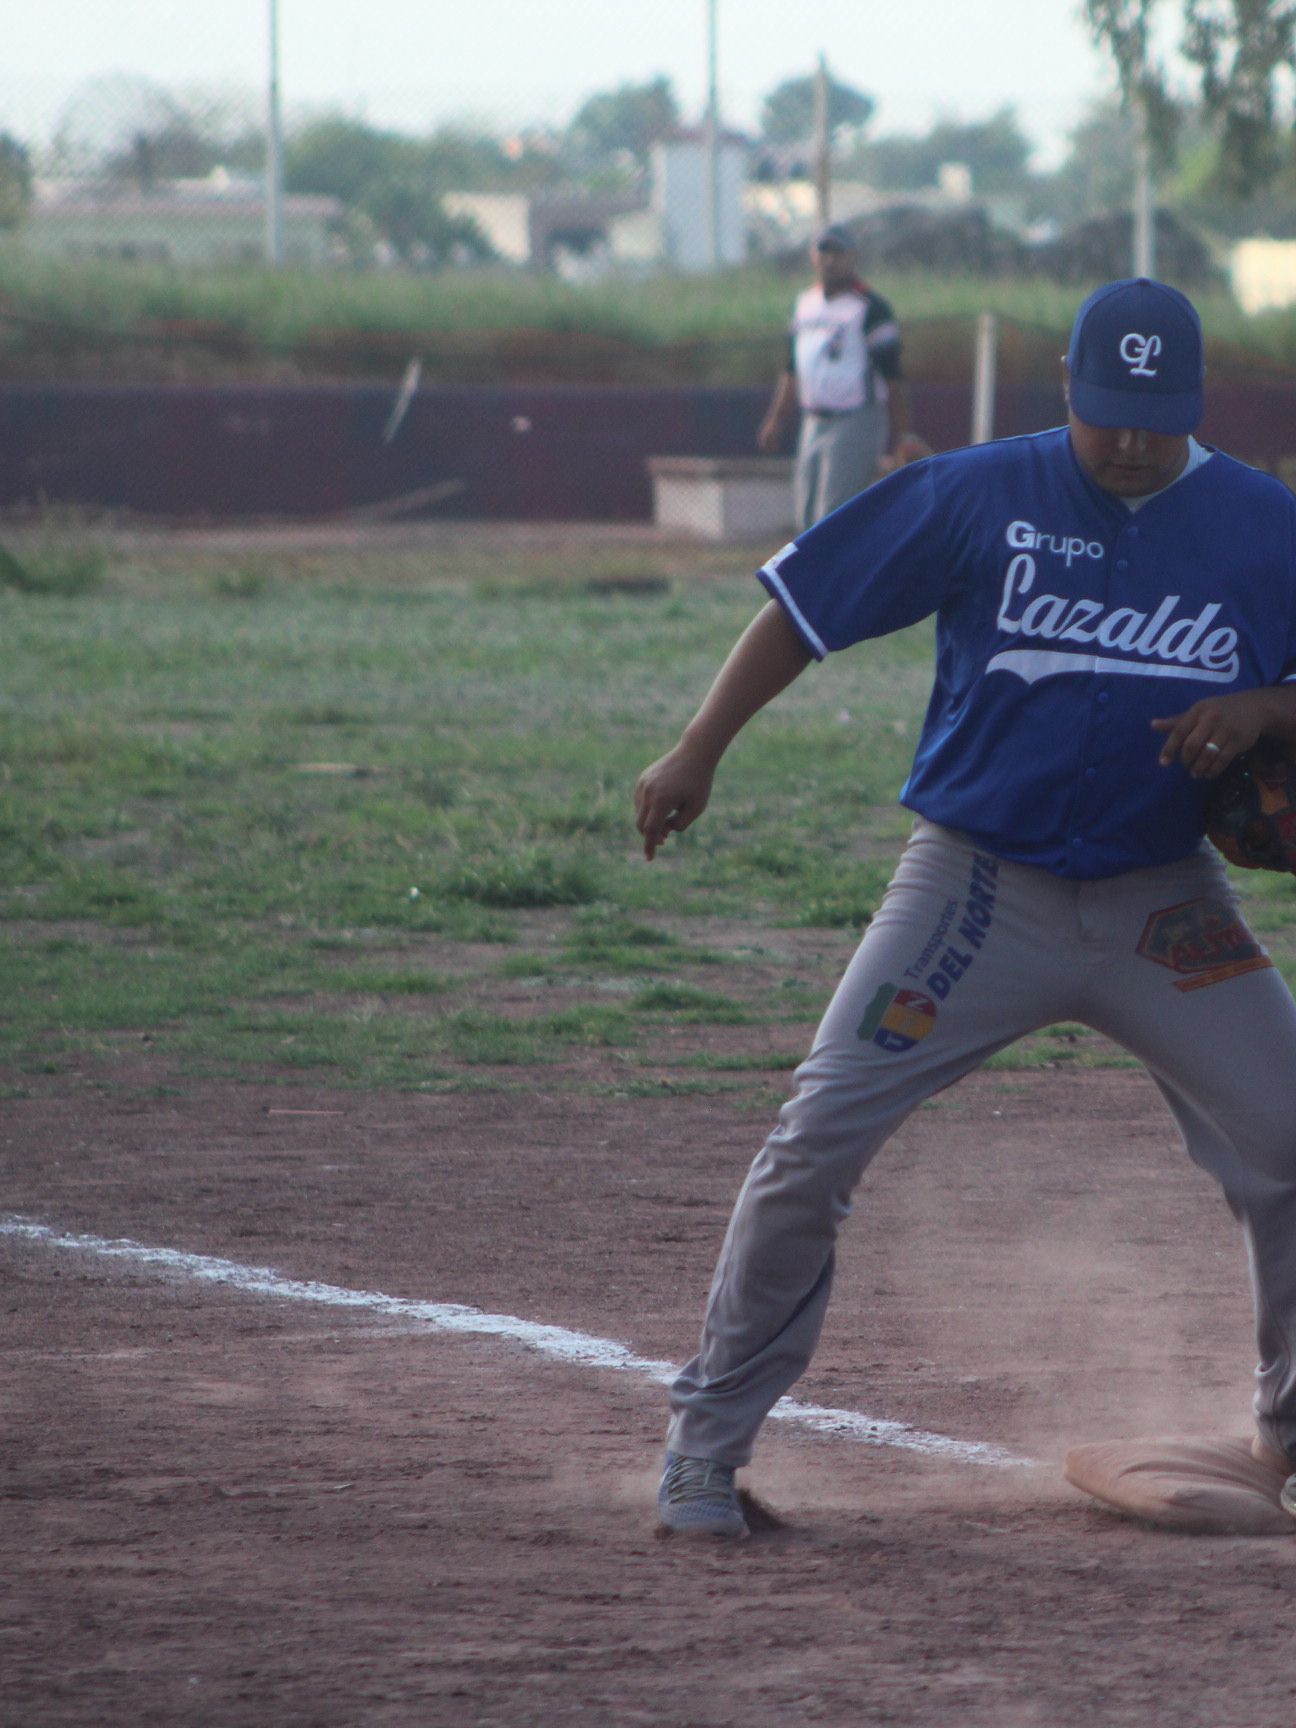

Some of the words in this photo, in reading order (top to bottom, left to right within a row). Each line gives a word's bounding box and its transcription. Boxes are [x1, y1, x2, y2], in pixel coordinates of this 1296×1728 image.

[1006, 520, 1104, 568] Grupo
[997, 553, 1238, 671] Lazalde
[904, 900, 958, 979] Transportes
[926, 946, 974, 1000] DEL
[958, 852, 999, 950] NORTE
